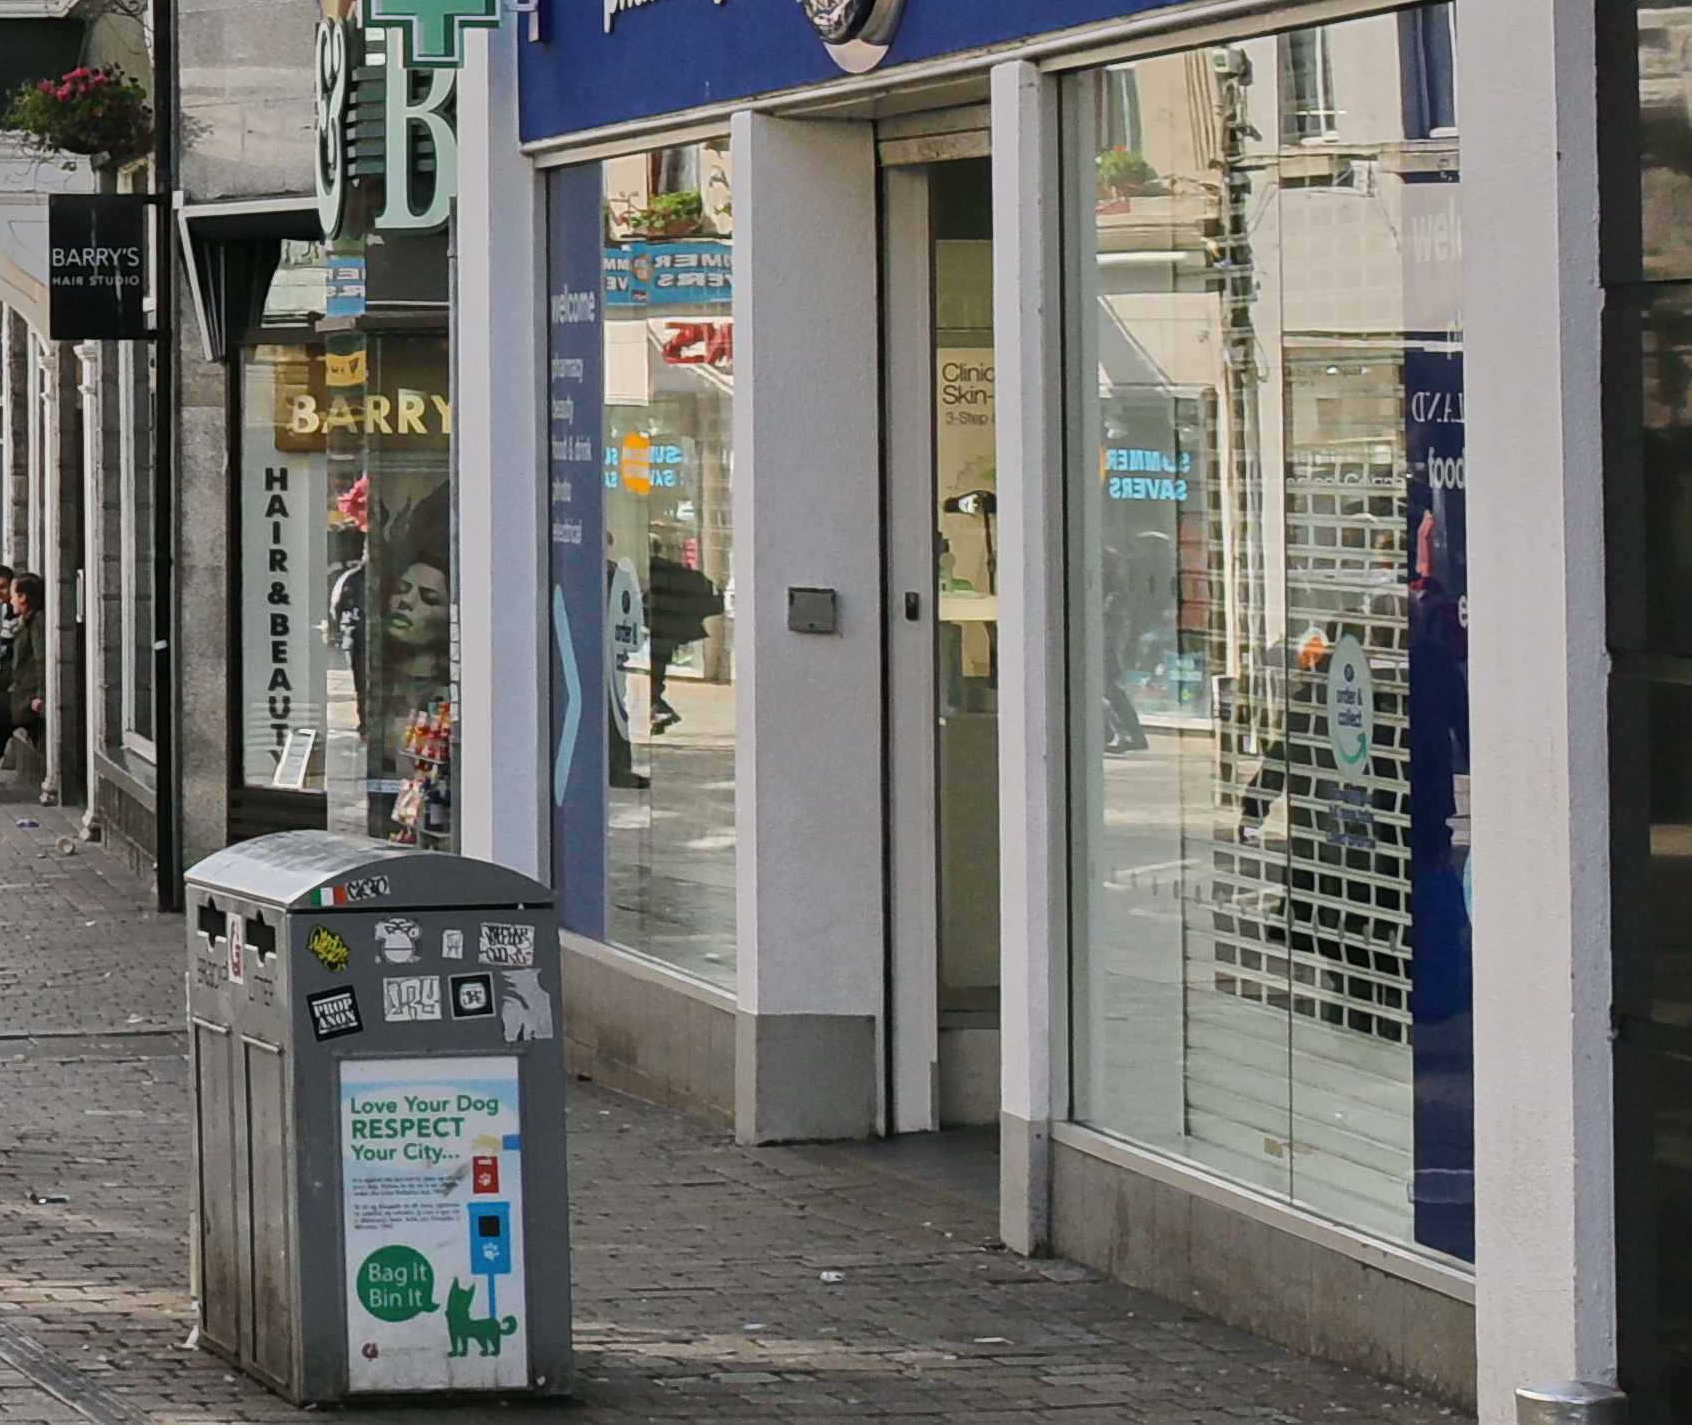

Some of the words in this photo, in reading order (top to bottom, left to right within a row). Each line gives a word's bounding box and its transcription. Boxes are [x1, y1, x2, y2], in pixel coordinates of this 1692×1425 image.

[52, 246, 140, 267] BARRY'S
[52, 276, 83, 286] HAIR
[89, 275, 140, 286] STUDIO
[265, 467, 289, 573] HAIR
[314, 997, 353, 1018] PROP
[318, 1009, 356, 1030] ANON
[350, 1096, 398, 1115] Love
[403, 1095, 450, 1113] Your
[456, 1094, 500, 1116] Dog
[351, 1117, 465, 1140] RESPECT
[350, 1144, 397, 1162] Your
[402, 1143, 460, 1165] City...
[368, 1262, 408, 1287] Bag
[413, 1262, 428, 1282] It
[368, 1289, 403, 1308] Bin
[408, 1289, 423, 1308] It
